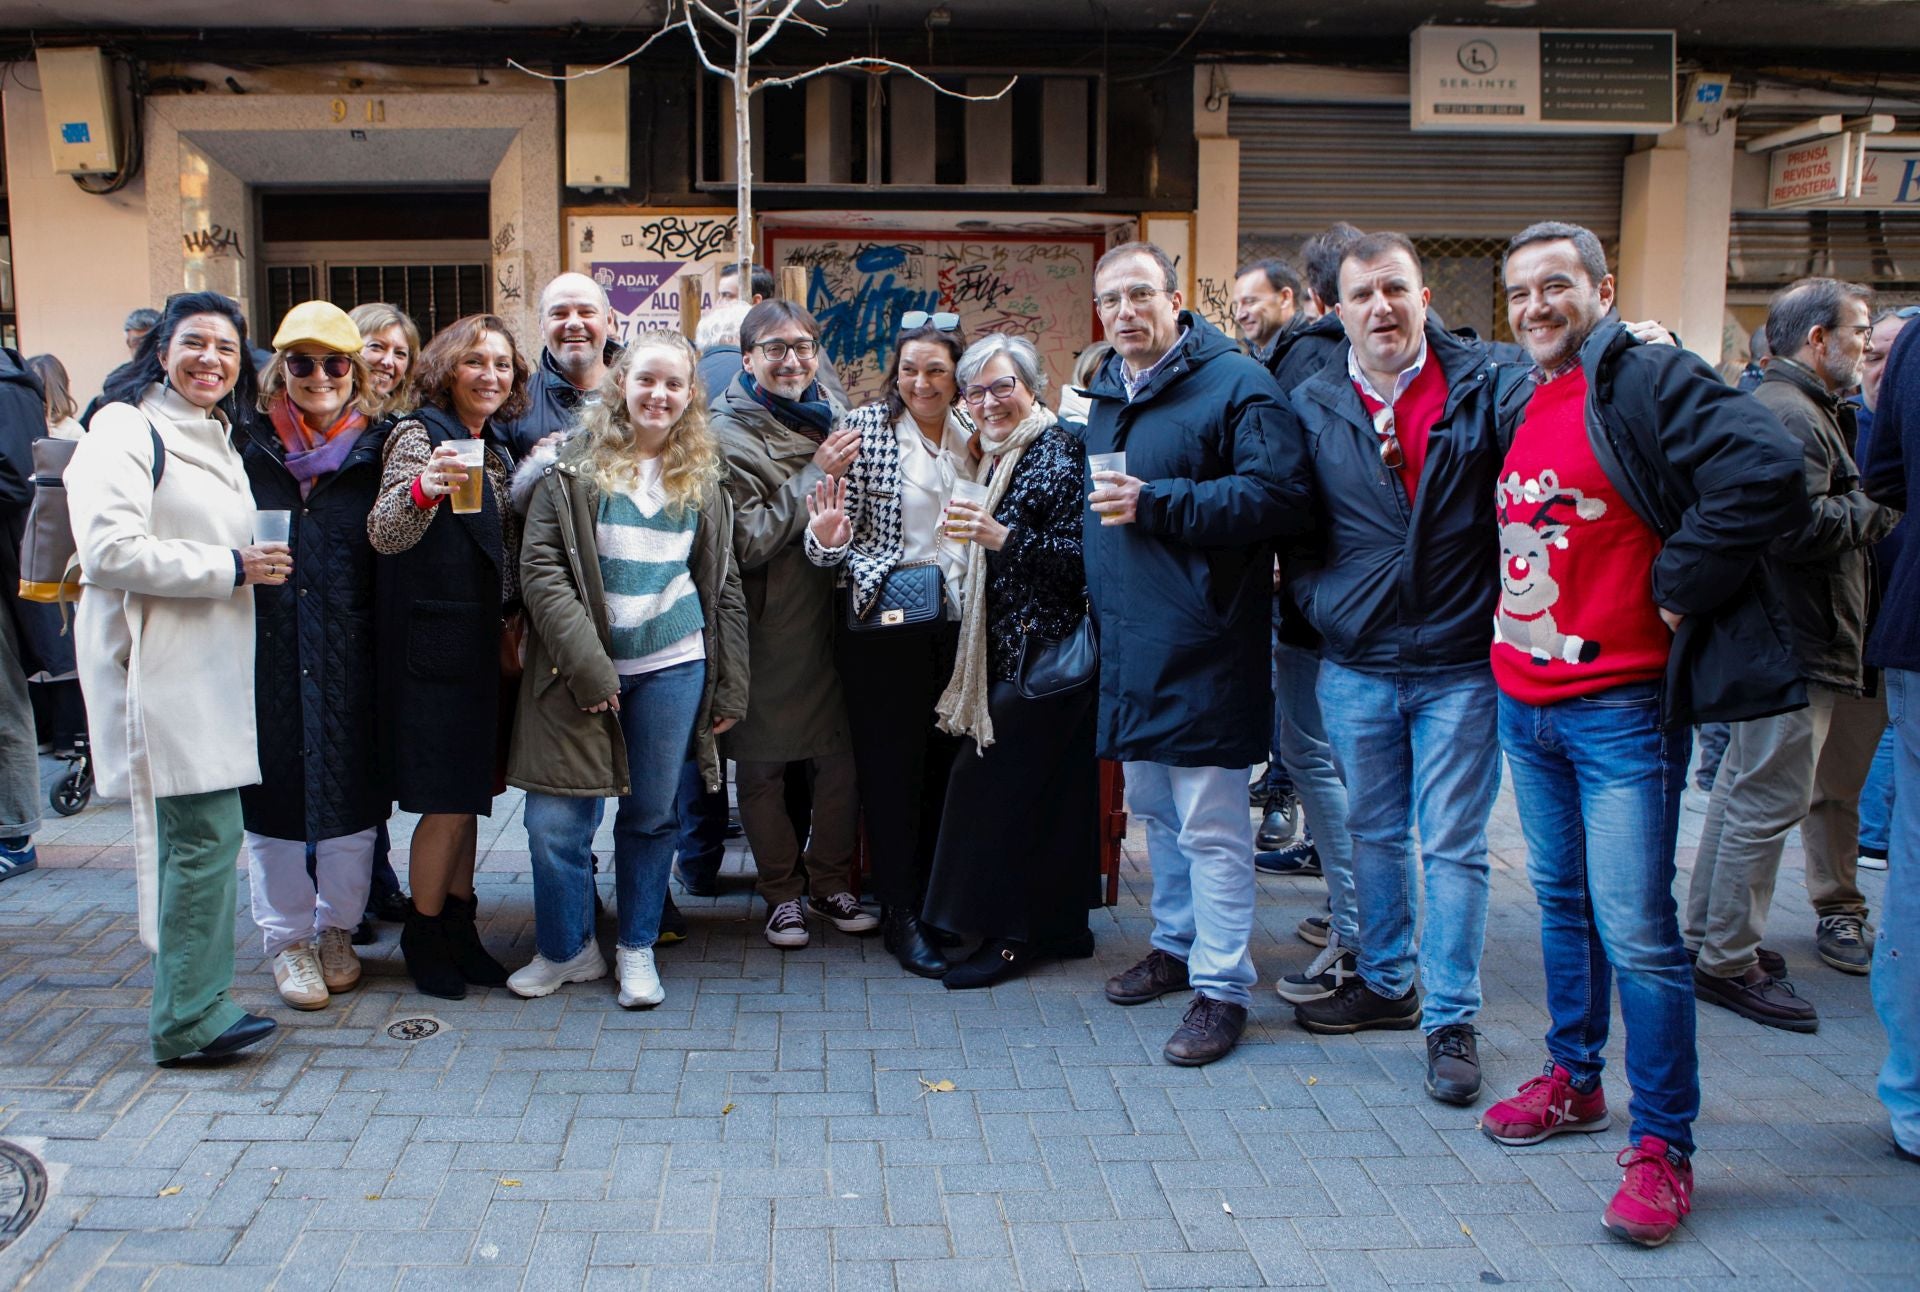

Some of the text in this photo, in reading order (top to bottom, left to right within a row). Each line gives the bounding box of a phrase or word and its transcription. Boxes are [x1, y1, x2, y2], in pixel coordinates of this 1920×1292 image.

[1439, 78, 1517, 89] SER-INTE
[331, 98, 385, 123] 9 11
[1787, 146, 1828, 165] PRENSA
[1782, 162, 1831, 182] REVISTAS
[1774, 179, 1837, 200] REPOSTERIA
[617, 274, 660, 287] ADAIX
